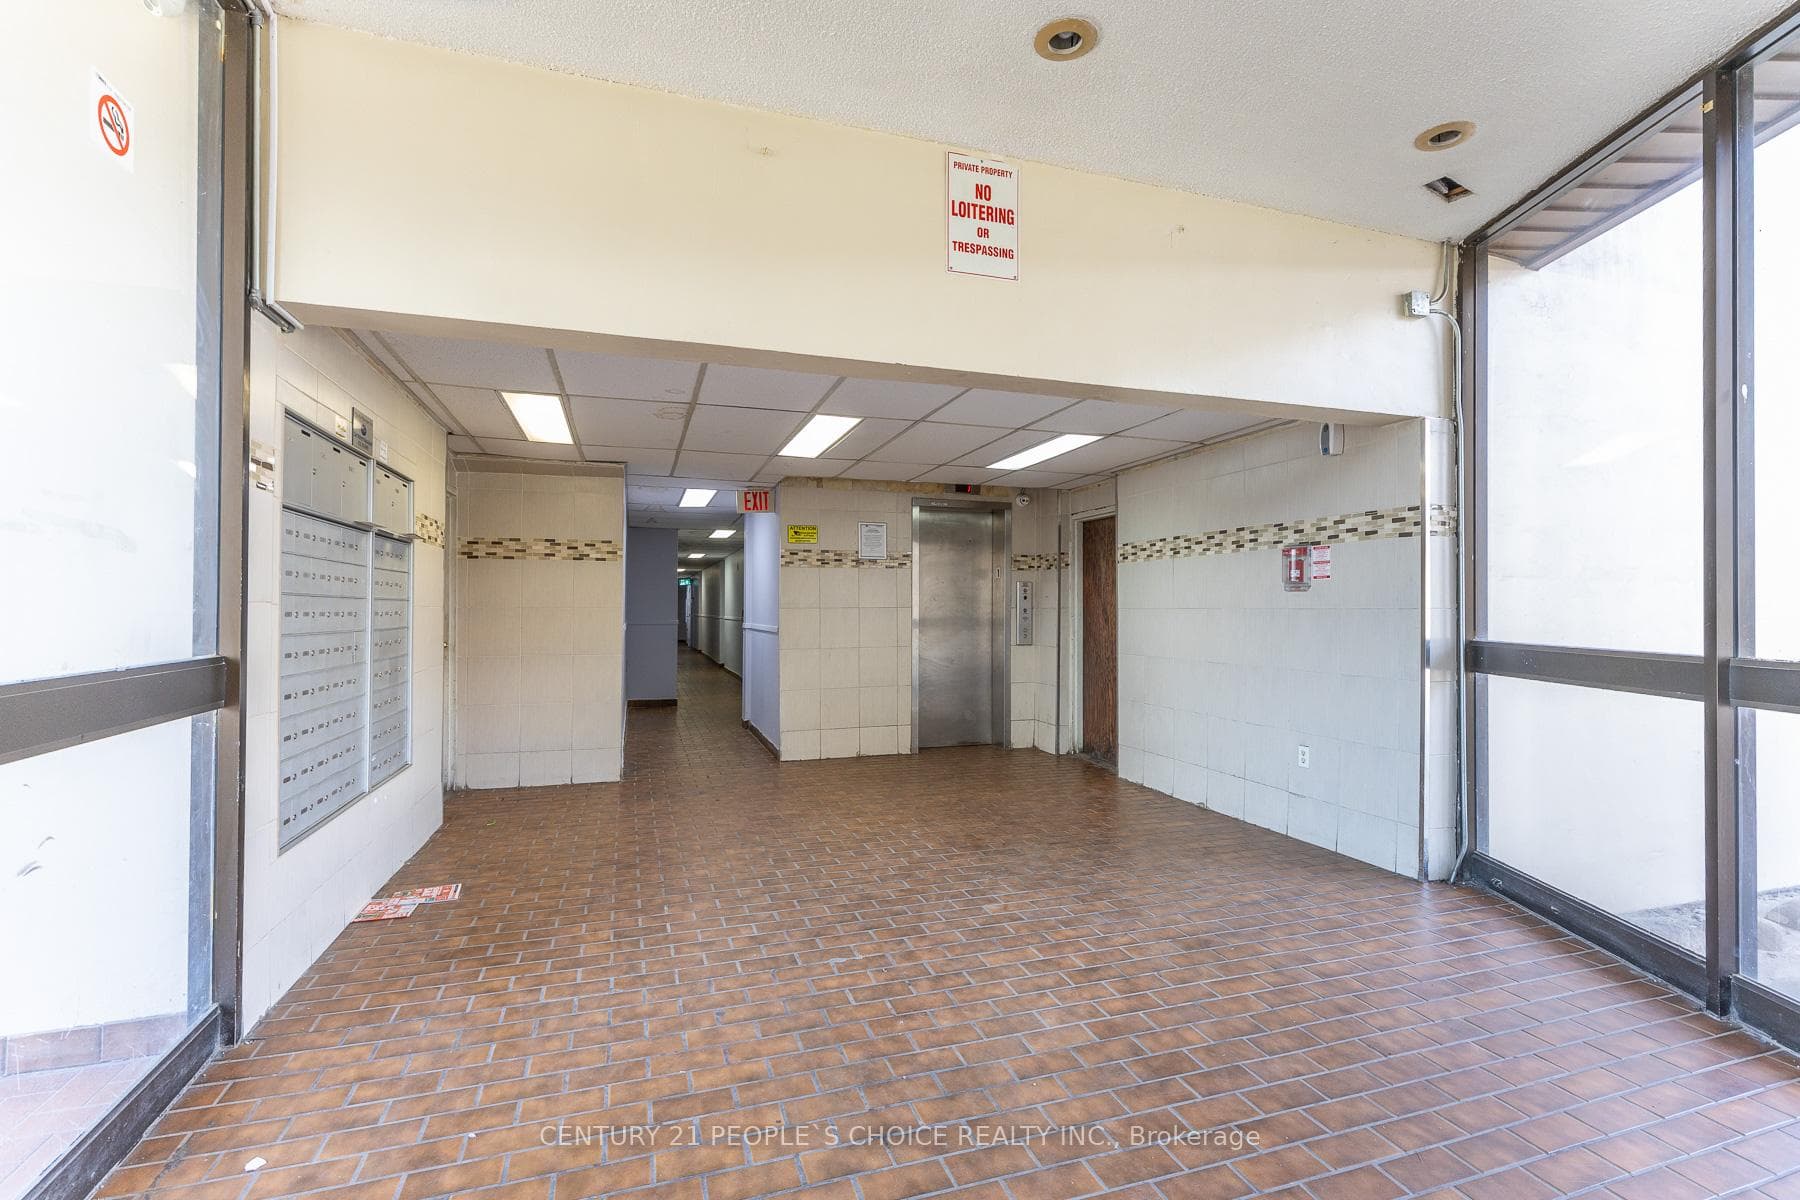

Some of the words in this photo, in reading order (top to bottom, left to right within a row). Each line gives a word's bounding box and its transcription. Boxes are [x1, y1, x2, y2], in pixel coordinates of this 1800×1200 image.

[953, 161, 979, 173] PRIVATE
[980, 166, 1013, 179] PROPERTY
[975, 183, 992, 201] NO
[951, 200, 1015, 226] LOITERING
[976, 227, 990, 239] OR
[952, 240, 1014, 260] TRESPASSING
[743, 490, 769, 511] EXIT
